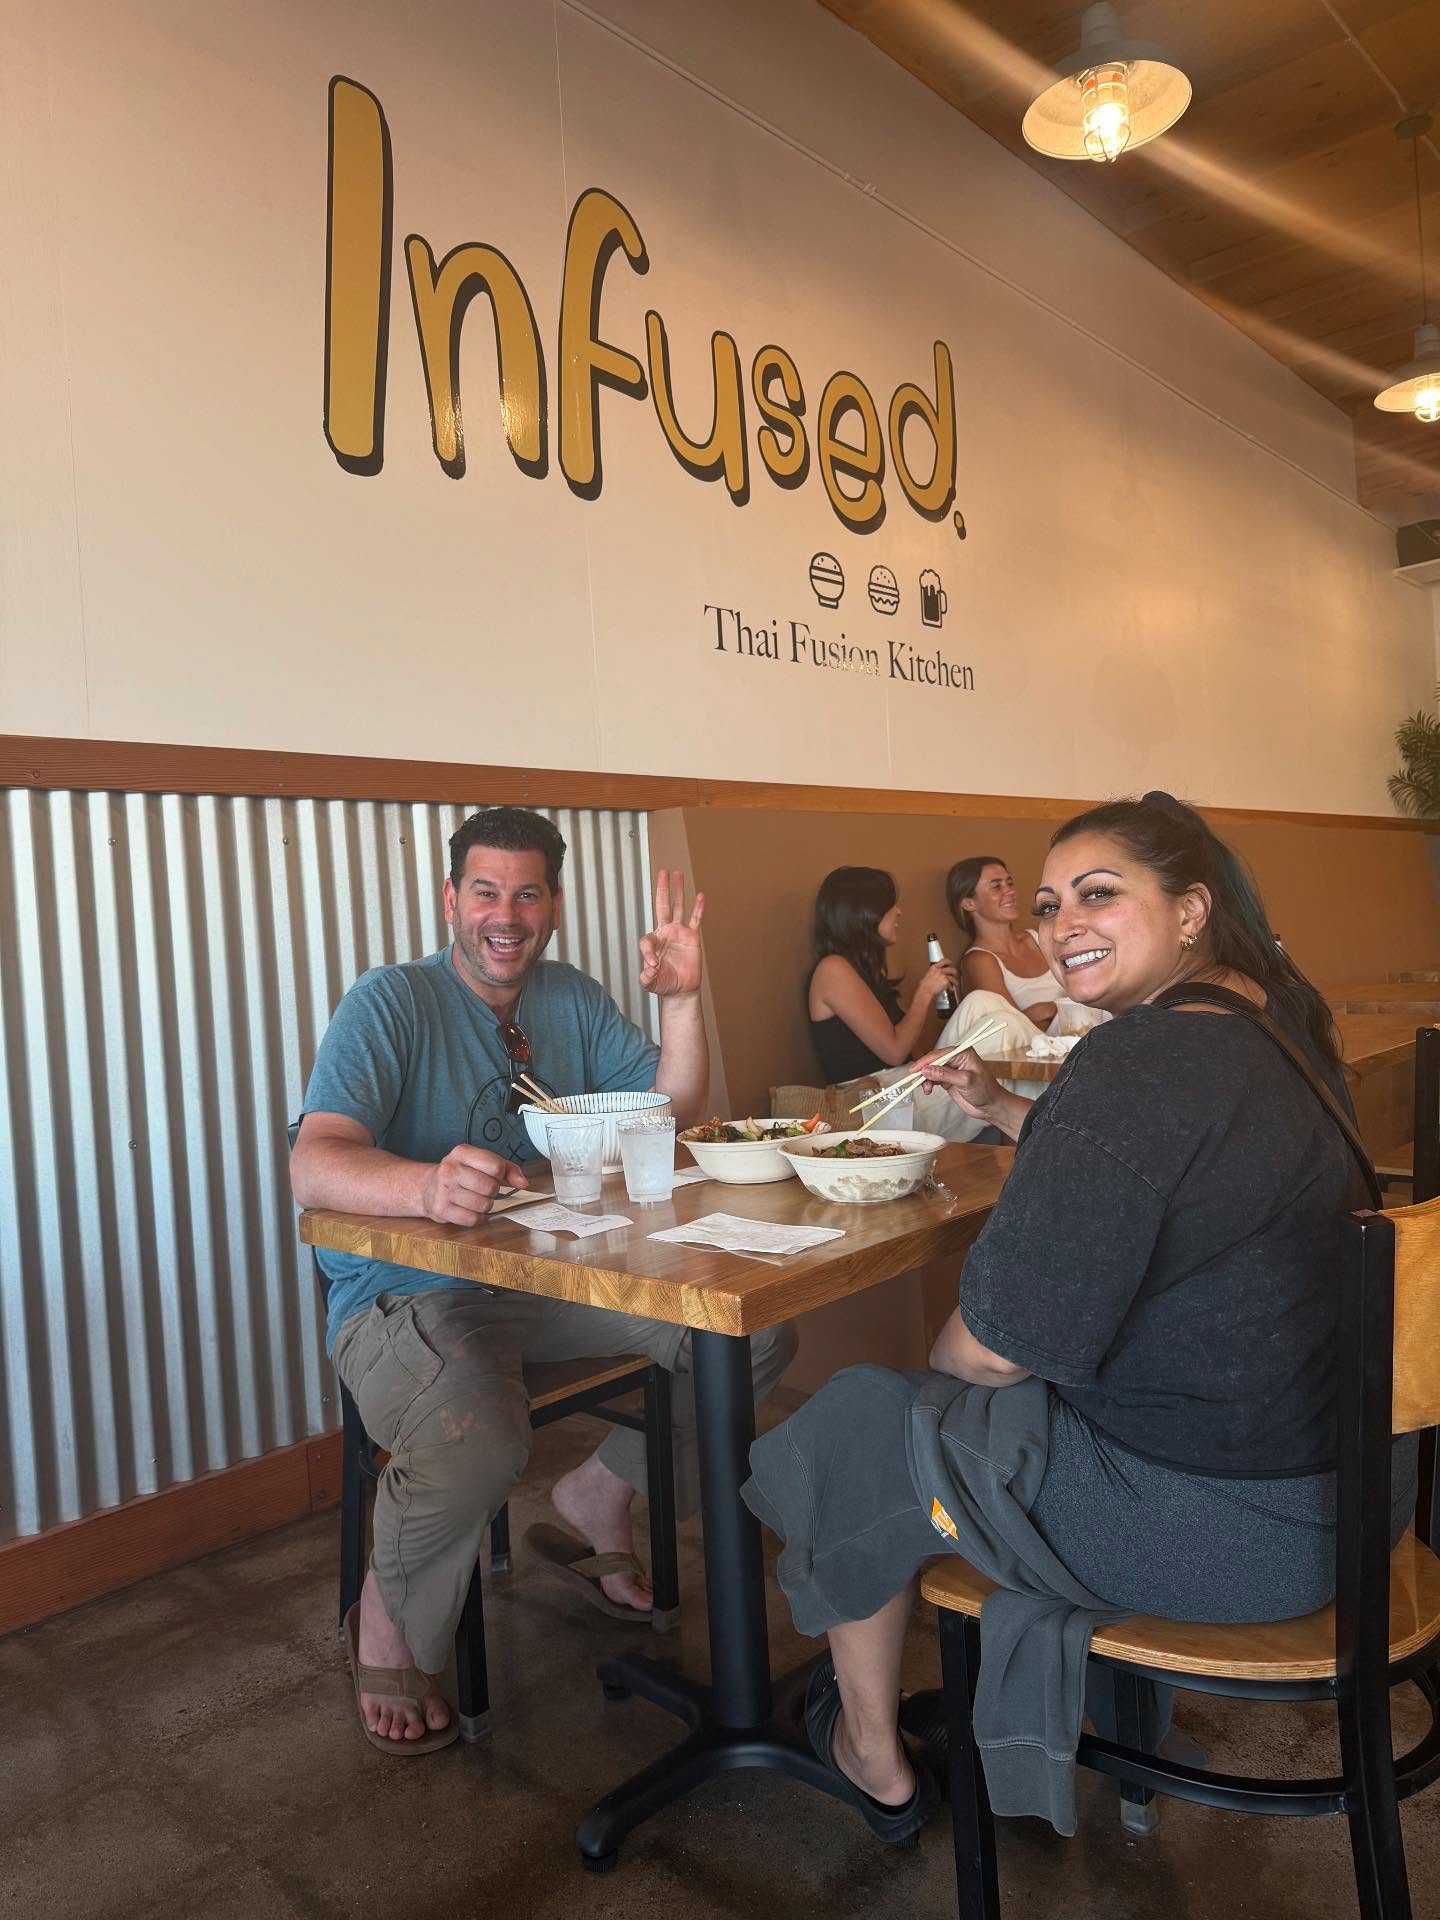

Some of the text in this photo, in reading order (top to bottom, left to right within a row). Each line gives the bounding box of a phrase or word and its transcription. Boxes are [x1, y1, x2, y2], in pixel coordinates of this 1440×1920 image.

[703, 604, 975, 691] Thai Fusion Kitchen
